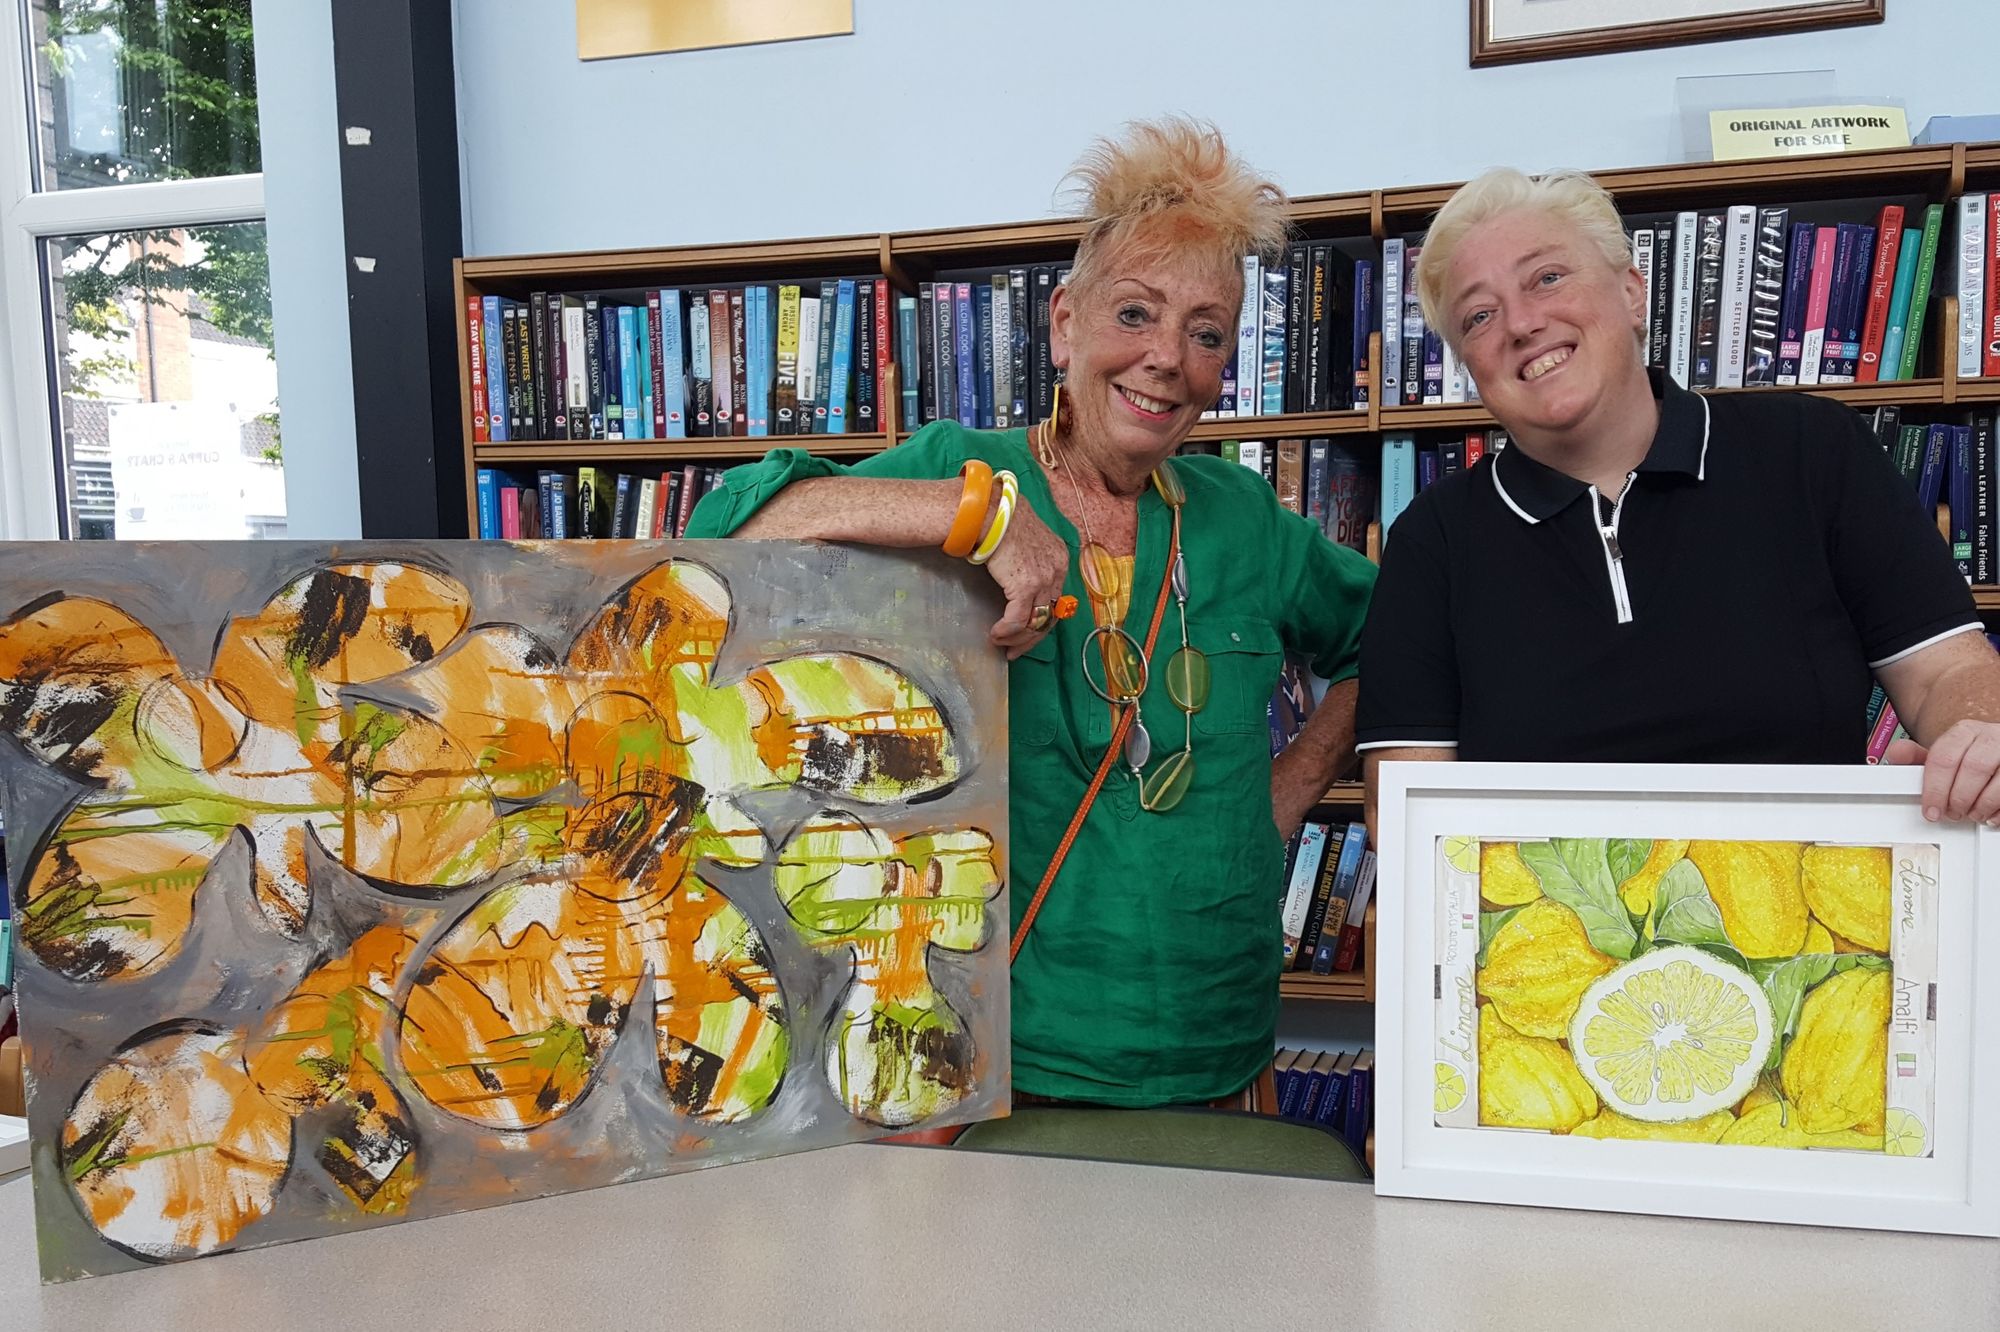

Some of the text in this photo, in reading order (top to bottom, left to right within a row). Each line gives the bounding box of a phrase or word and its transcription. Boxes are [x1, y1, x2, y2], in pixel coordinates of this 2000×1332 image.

[1729, 116, 1890, 132] ORIGINAL ARTWORK
[1774, 134, 1852, 147] FOR SALE
[1639, 252, 1650, 275] DEAD
[1657, 240, 1668, 315] SUGAR AND SPICE
[1681, 233, 1692, 291] Alan Hammond
[1736, 234, 1748, 292] MARI HANNAH
[1874, 226, 1897, 299] The Strawberry Thief
[1916, 224, 1936, 306] DEATH ON THE CHERWELL
[861, 298, 869, 313] NOR
[993, 294, 1001, 327] MURDER
[1248, 282, 1256, 313] YASMIN
[1291, 266, 1302, 324] Judith Cutler
[1313, 265, 1323, 323] ARNE DAHL
[1386, 260, 1398, 343] THE BOY IN THE PARK
[471, 320, 481, 342] STAY
[586, 312, 595, 355] ALVTEGEN
[665, 307, 673, 351] ANDREWS
[781, 309, 790, 333] ARCHER
[788, 306, 797, 330] URSULA
[877, 297, 887, 352] JUDY ASTLEY
[940, 302, 951, 367] GLORIA COOK
[959, 302, 969, 356] GLORIA COOK
[994, 326, 1001, 334] IN
[1312, 326, 1319, 335] To
[1679, 310, 1688, 324] Fair
[1730, 301, 1742, 365] SETTLED BLOOD
[505, 321, 519, 385] PAST TENSE
[519, 318, 531, 381] LAST WRITES
[655, 330, 664, 366] Liverpool
[861, 341, 870, 369] SLEEP
[982, 301, 993, 373] ROBIN COOK
[1000, 302, 1011, 385] LESLEY COOKMAN
[1290, 327, 1300, 374] HEAD START
[1310, 346, 1318, 357] Top
[1653, 319, 1663, 362] HAMILTON
[1677, 333, 1686, 348] Love
[1677, 349, 1685, 361] and
[1905, 310, 1921, 368] MAVIS DORIEL HAY
[471, 342, 481, 369] WITH
[731, 355, 745, 375] Girls
[778, 352, 796, 385] FIVE
[1240, 349, 1248, 374] Kitchen
[1246, 344, 1254, 380] The Saffron
[1310, 366, 1318, 376] the
[1408, 339, 1418, 380] IRISH TWEED
[1676, 362, 1684, 375] Law
[472, 370, 482, 386] ME
[591, 358, 600, 397] SHADOW
[653, 368, 663, 414] lyn andrews
[859, 371, 867, 402] ASHTON
[1039, 342, 1047, 407] DEATH OF KINGS
[1310, 376, 1318, 405] Mountain
[508, 393, 516, 408] Aird
[512, 385, 521, 416] Catherine
[526, 382, 535, 416] CATHERINE
[733, 379, 741, 409] ARCHER
[879, 379, 887, 424] Summertime
[943, 393, 951, 416] Shades
[1912, 428, 1922, 447] Anne
[1290, 485, 1298, 498] EVA
[1977, 431, 1987, 518] Stephen LEATHER
[541, 484, 551, 525] LIVERPOOL
[554, 493, 562, 504] JO
[616, 494, 625, 515] TESSA
[679, 484, 689, 522] BELINDA
[1337, 519, 1363, 543] DIE
[1978, 524, 1988, 581] False Friends
[1874, 725, 1891, 750] Hussain
[1318, 840, 1342, 900] THE BLACK JACKALS
[1286, 886, 1307, 934] Italian Wife
[1306, 901, 1325, 945] IAIN GALE
[1439, 965, 1474, 1063] Limone
[1895, 977, 1920, 1036] Amalfi
